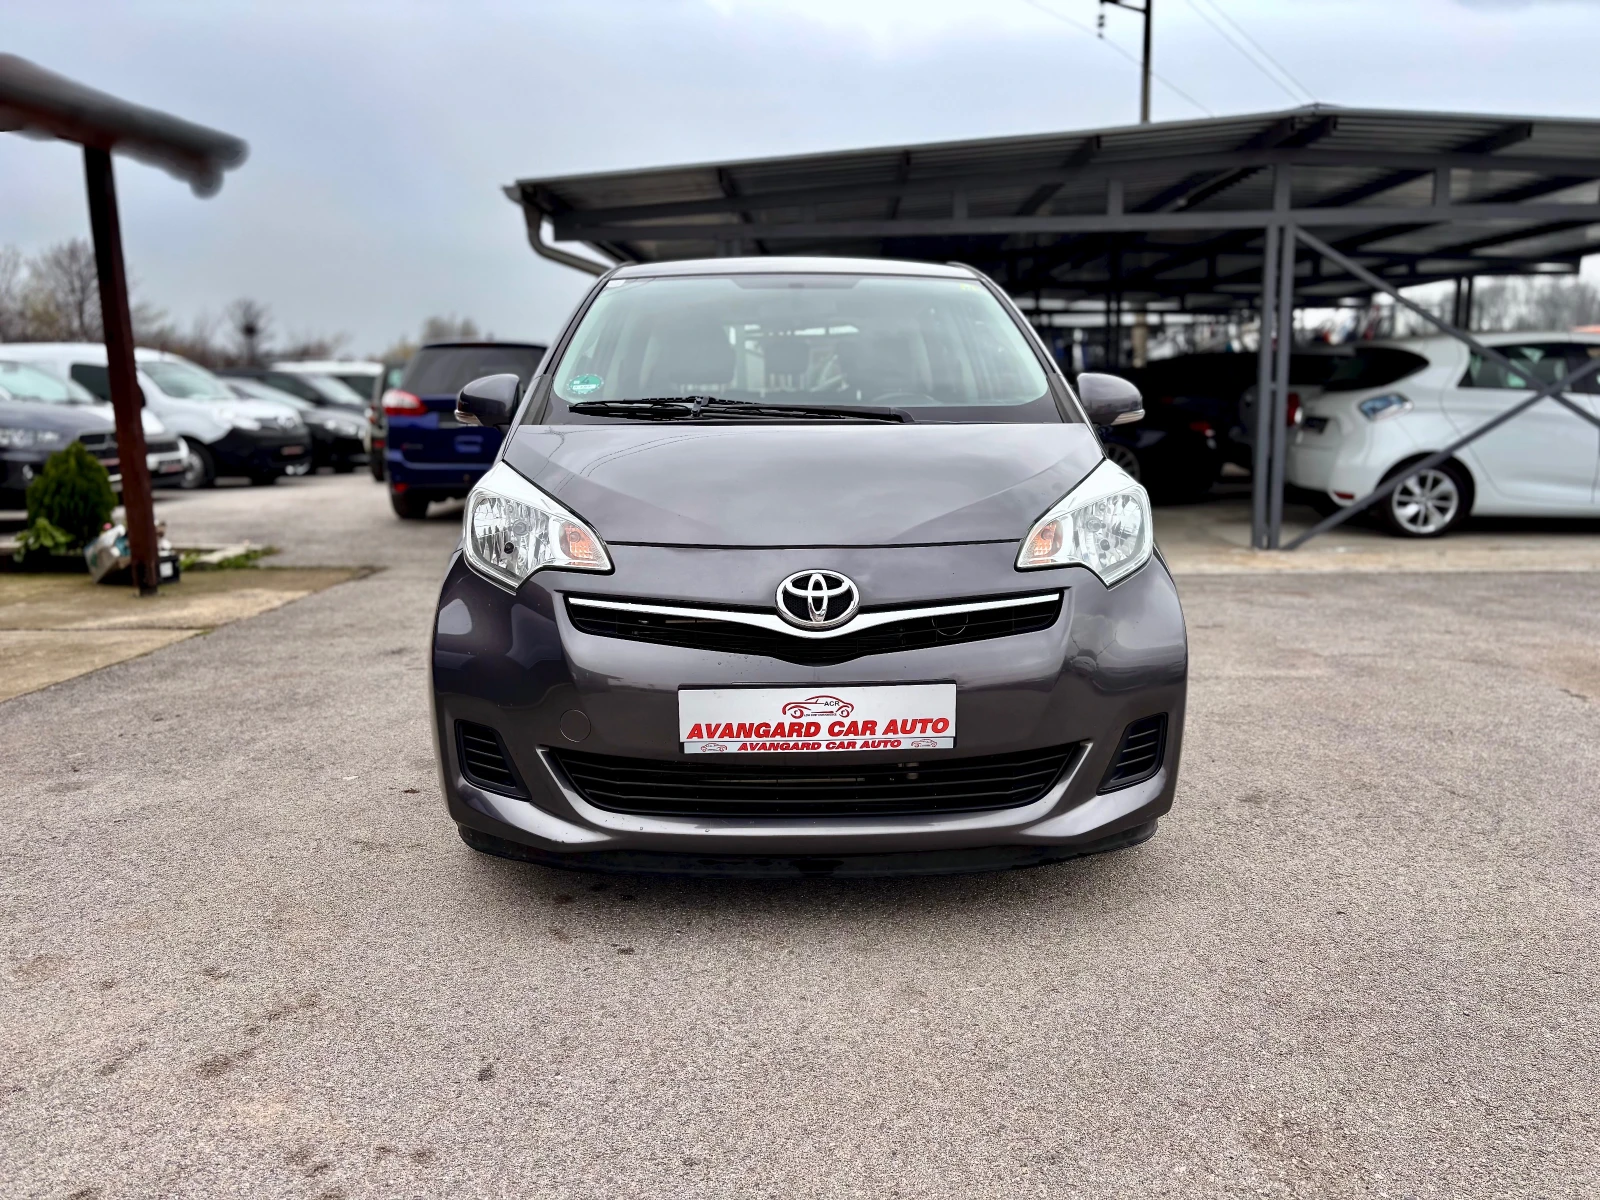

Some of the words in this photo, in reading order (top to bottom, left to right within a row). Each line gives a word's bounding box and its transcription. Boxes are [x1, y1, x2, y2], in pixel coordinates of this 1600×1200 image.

[686, 721, 821, 740] AVANGARD
[828, 720, 877, 737] CAR
[882, 717, 949, 735] AUTO
[737, 741, 822, 751] AVANGARD
[825, 741, 857, 750] CAR
[860, 739, 901, 749] AUTO
